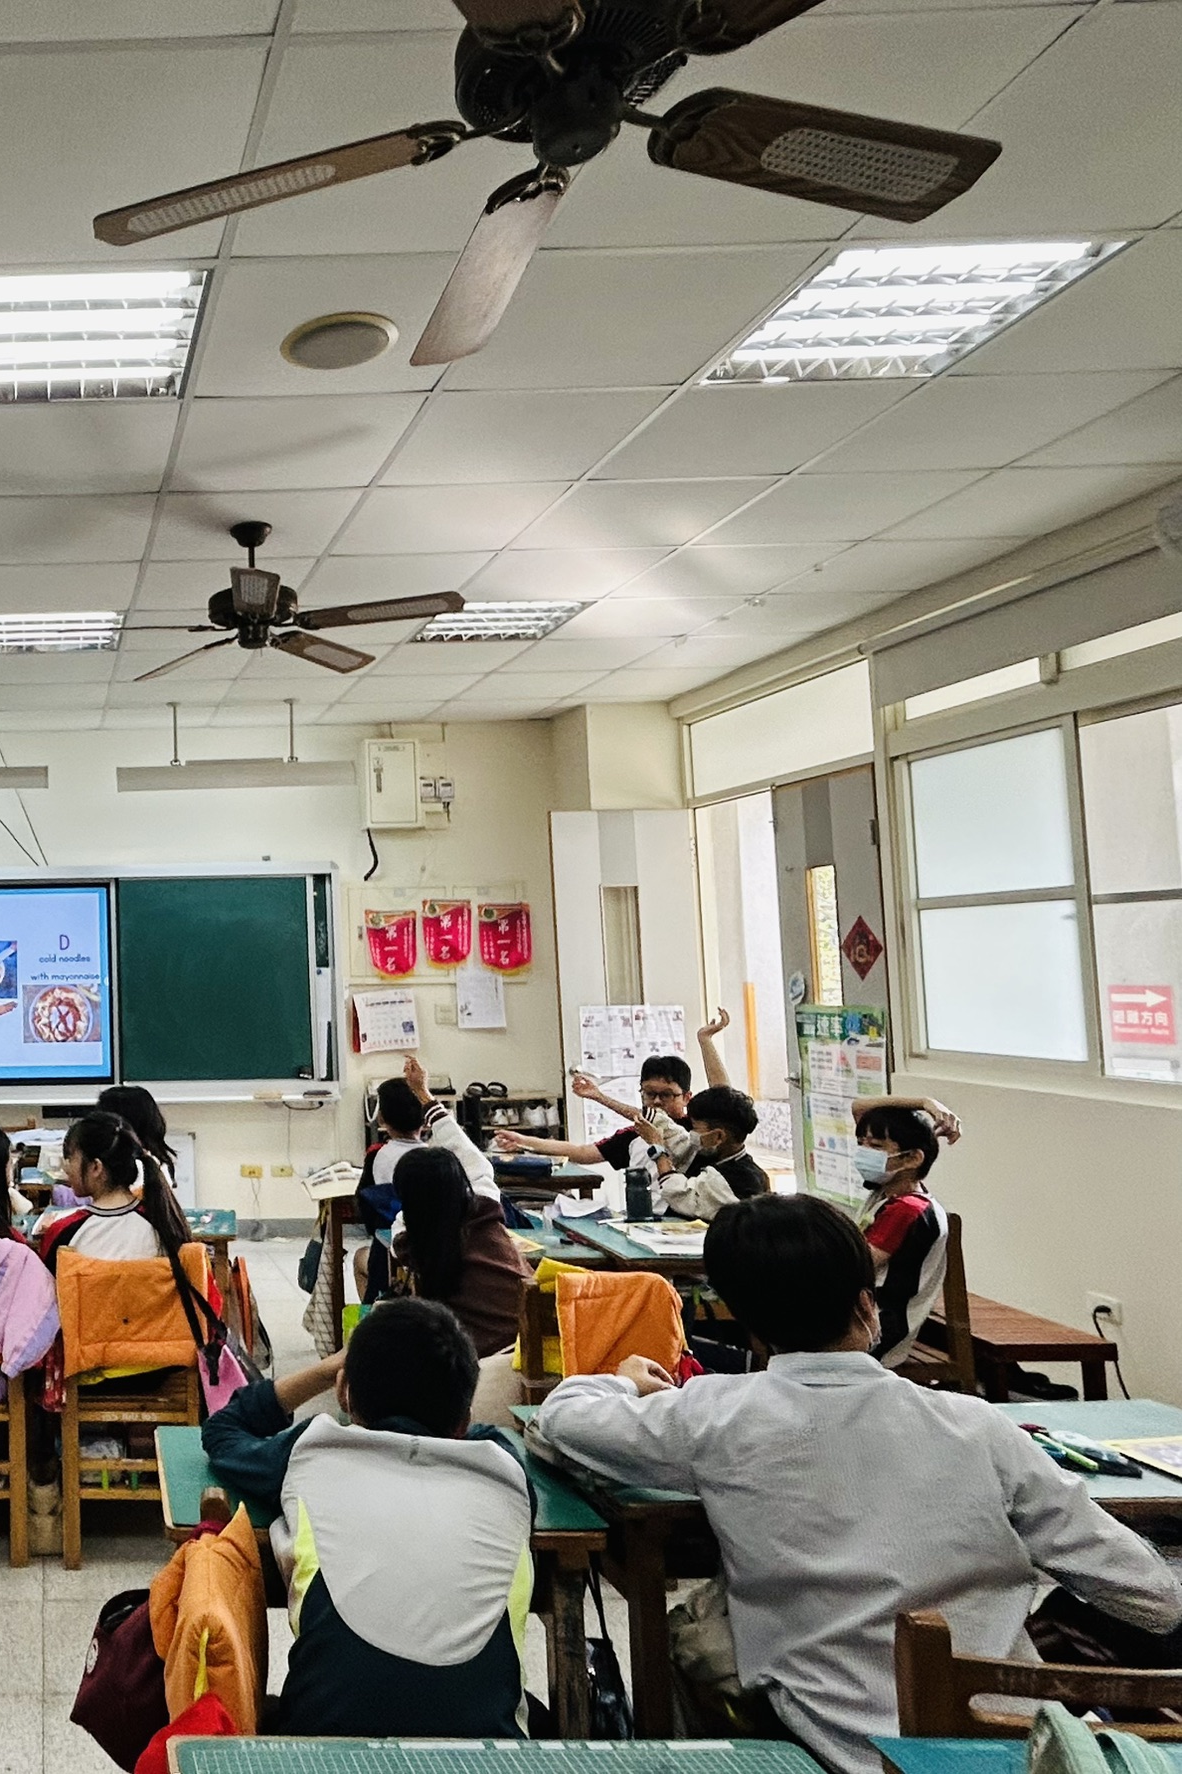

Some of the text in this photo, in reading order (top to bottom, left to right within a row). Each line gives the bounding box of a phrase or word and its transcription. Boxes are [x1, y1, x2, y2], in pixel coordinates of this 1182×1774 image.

[59, 934, 70, 950] D
[383, 925, 398, 972] 第一名
[438, 914, 453, 960] 第一名
[497, 919, 511, 965] 第一名
[39, 954, 91, 963] cold noodles
[30, 972, 100, 983] with mayonnaise
